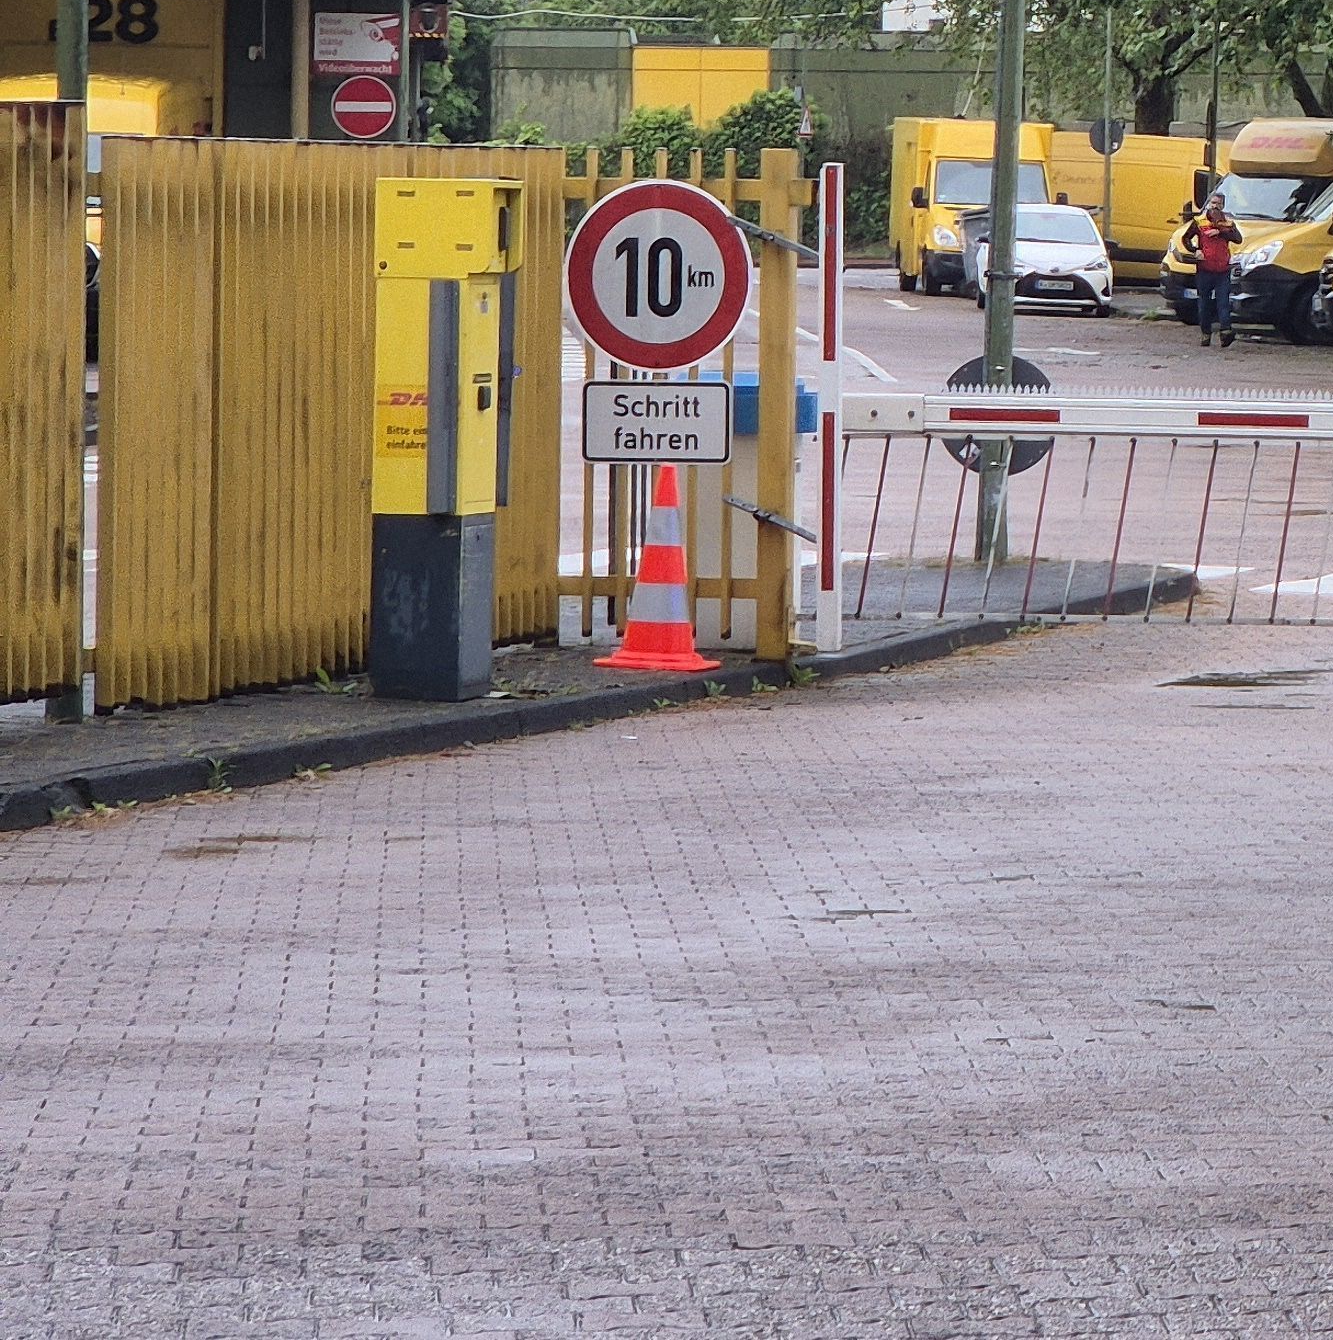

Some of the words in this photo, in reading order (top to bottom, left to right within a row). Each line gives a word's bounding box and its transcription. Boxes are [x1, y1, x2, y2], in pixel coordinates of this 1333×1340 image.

[614, 237, 683, 318] 10
[687, 264, 715, 288] km
[390, 392, 428, 406] DH
[612, 394, 701, 418] Schritt
[613, 426, 700, 451] fahren
